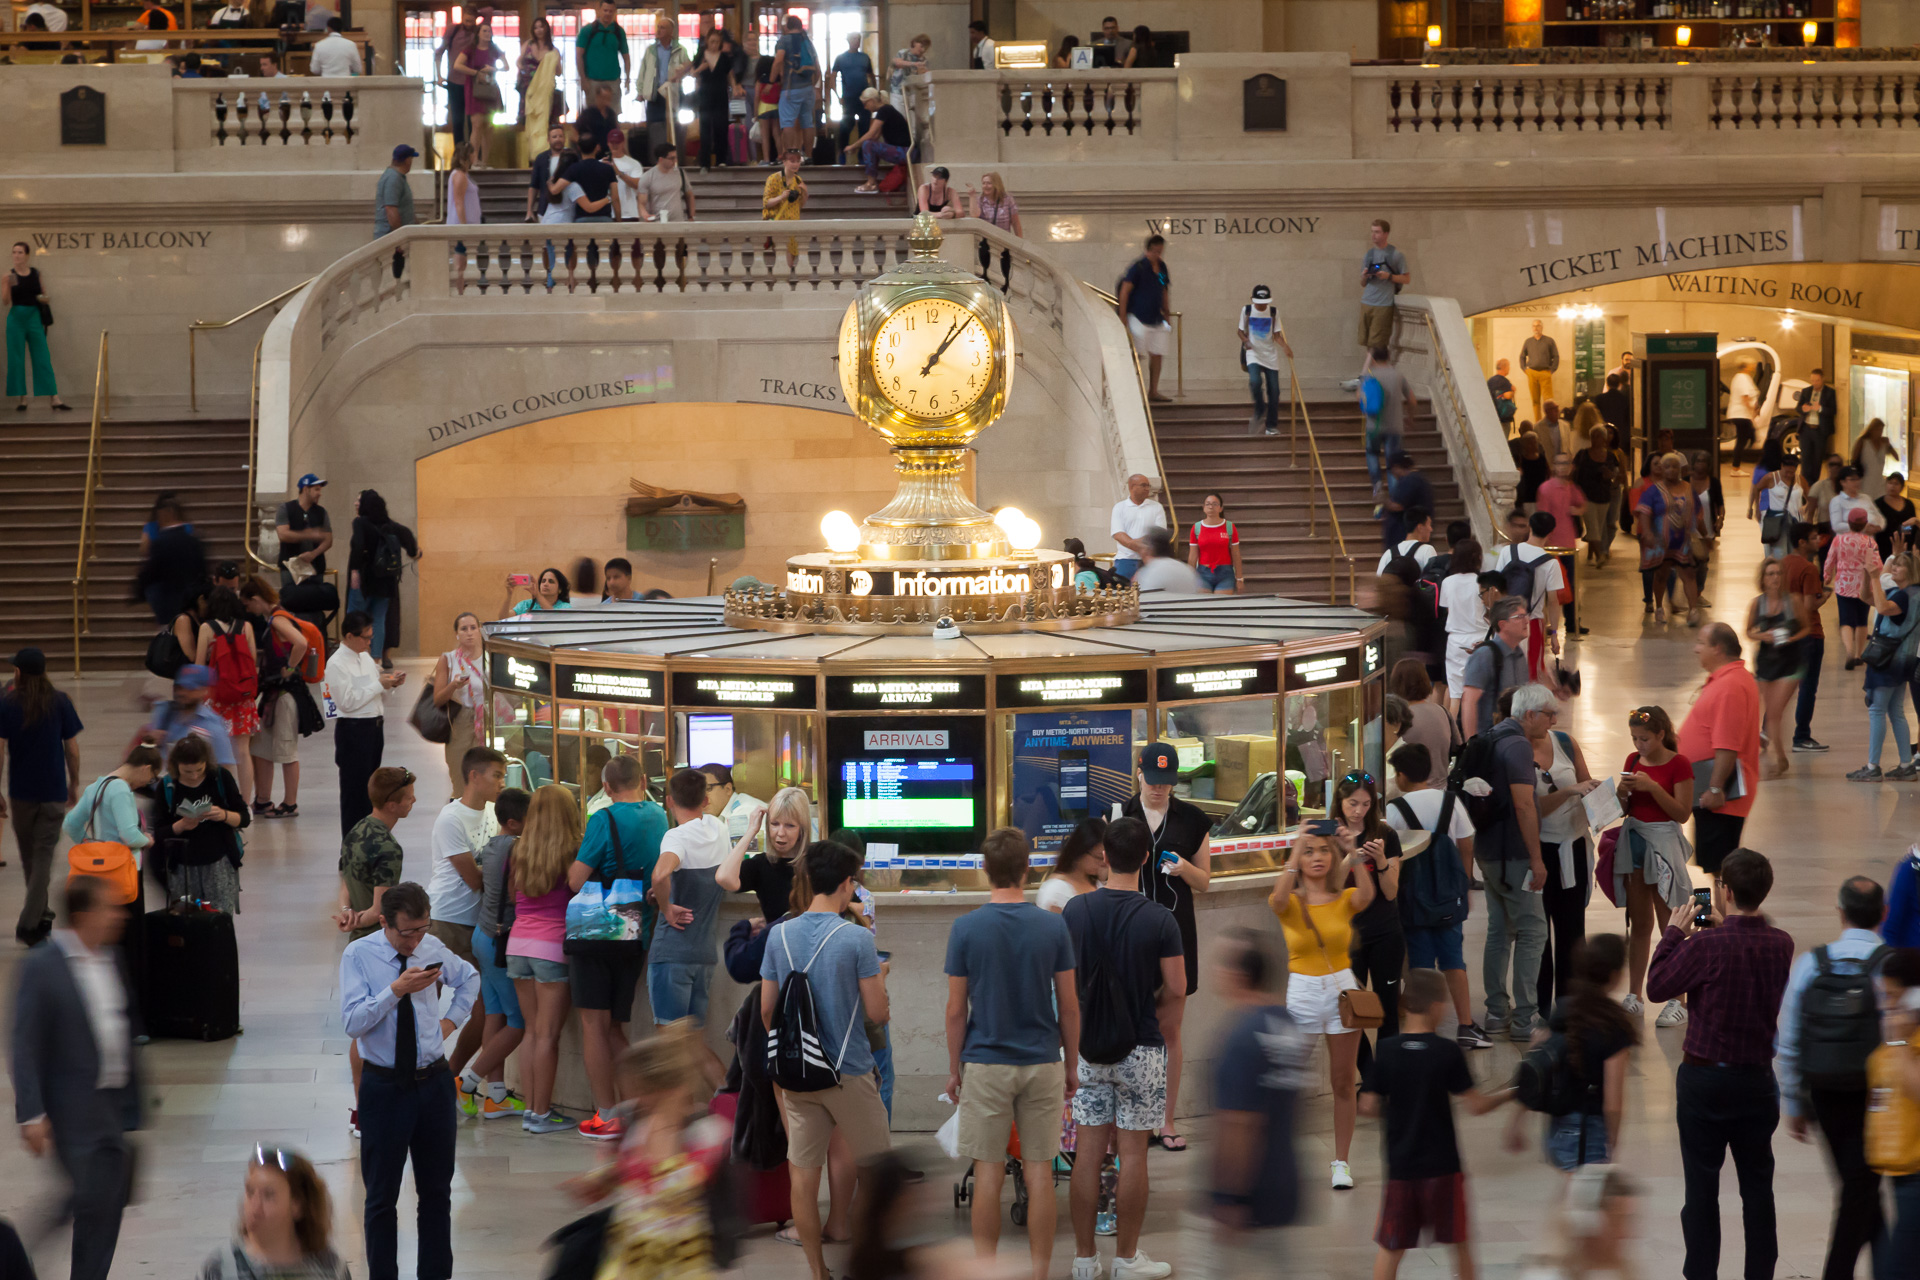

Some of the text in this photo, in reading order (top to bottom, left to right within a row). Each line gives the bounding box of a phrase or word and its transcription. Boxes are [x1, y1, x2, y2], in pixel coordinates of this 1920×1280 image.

[1076, 51, 1088, 63] A
[1146, 217, 1320, 235] WEST BALCONY
[32, 231, 212, 249] WEST BALCONY
[1520, 230, 1788, 287] TICKET MACHINES
[1667, 274, 1863, 309] WAITING ROOM
[905, 316, 915, 331] 11
[926, 309, 939, 324] 12
[889, 332, 901, 348] 10
[966, 327, 975, 342] 2
[886, 353, 894, 369] 9
[971, 351, 981, 367] 3
[892, 376, 901, 391] 8
[966, 374, 976, 388] 4
[760, 378, 837, 401] TRACKS
[908, 390, 917, 404] 7
[950, 390, 960, 404] 5
[929, 395, 939, 409] 6
[427, 380, 635, 441] DINING CONCOURSE
[645, 519, 730, 537] DINING
[893, 570, 1030, 596] Information
[572, 683, 652, 698] TRAIN INFORMATION
[697, 680, 719, 690] MTA
[853, 682, 960, 693] MTA METRO-NORTH
[1020, 678, 1122, 691] MTA METRO-NORTH
[880, 693, 932, 703] ARRIVALS
[1046, 728, 1089, 736] METRO-NORTH
[868, 734, 944, 746] ARRIVALS
[1024, 734, 1124, 748] ANYTIME, ANYWHERE
[1157, 755, 1168, 768] S
